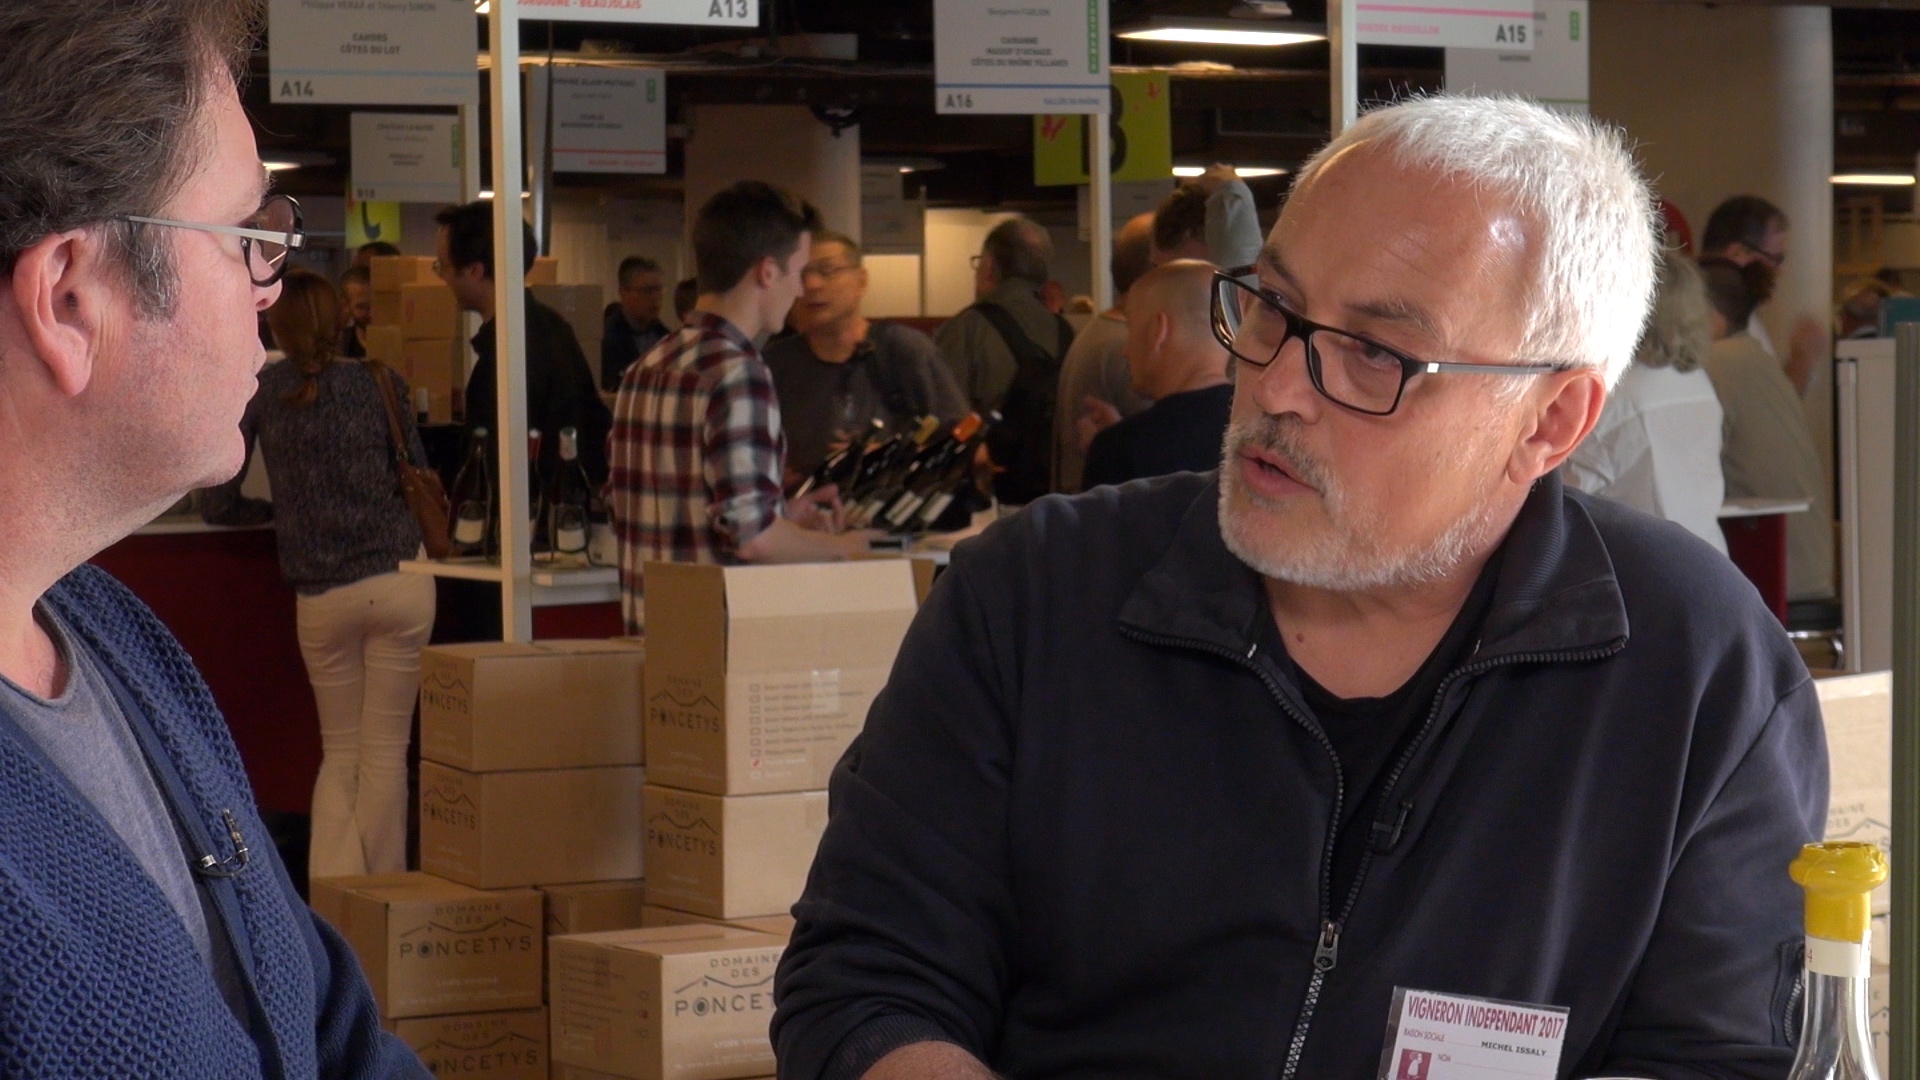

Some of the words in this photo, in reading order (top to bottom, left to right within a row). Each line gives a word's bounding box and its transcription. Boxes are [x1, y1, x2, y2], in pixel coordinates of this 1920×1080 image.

[708, 0, 748, 18] A13
[351, 32, 388, 42] CAHORS
[1495, 24, 1526, 43] A15
[384, 45, 400, 55] LOT
[280, 80, 314, 97] A14
[945, 94, 973, 108] A16
[650, 706, 720, 734] PONCETYS
[423, 802, 476, 830] PONCETYS
[648, 828, 716, 856] PONCETYS
[435, 903, 500, 915] DOMAINE
[400, 935, 532, 958] PONCETYS
[710, 952, 779, 968] DOMAINE
[731, 967, 760, 979] DES
[1408, 995, 1464, 1025] VIGNERON
[1464, 1004, 1538, 1036] INDEPENDANT
[1538, 1016, 1564, 1039] 2017
[1481, 1041, 1513, 1053] MICHEL
[1515, 1046, 1548, 1057] ISSALY
[428, 1050, 538, 1074] ONCETYS
